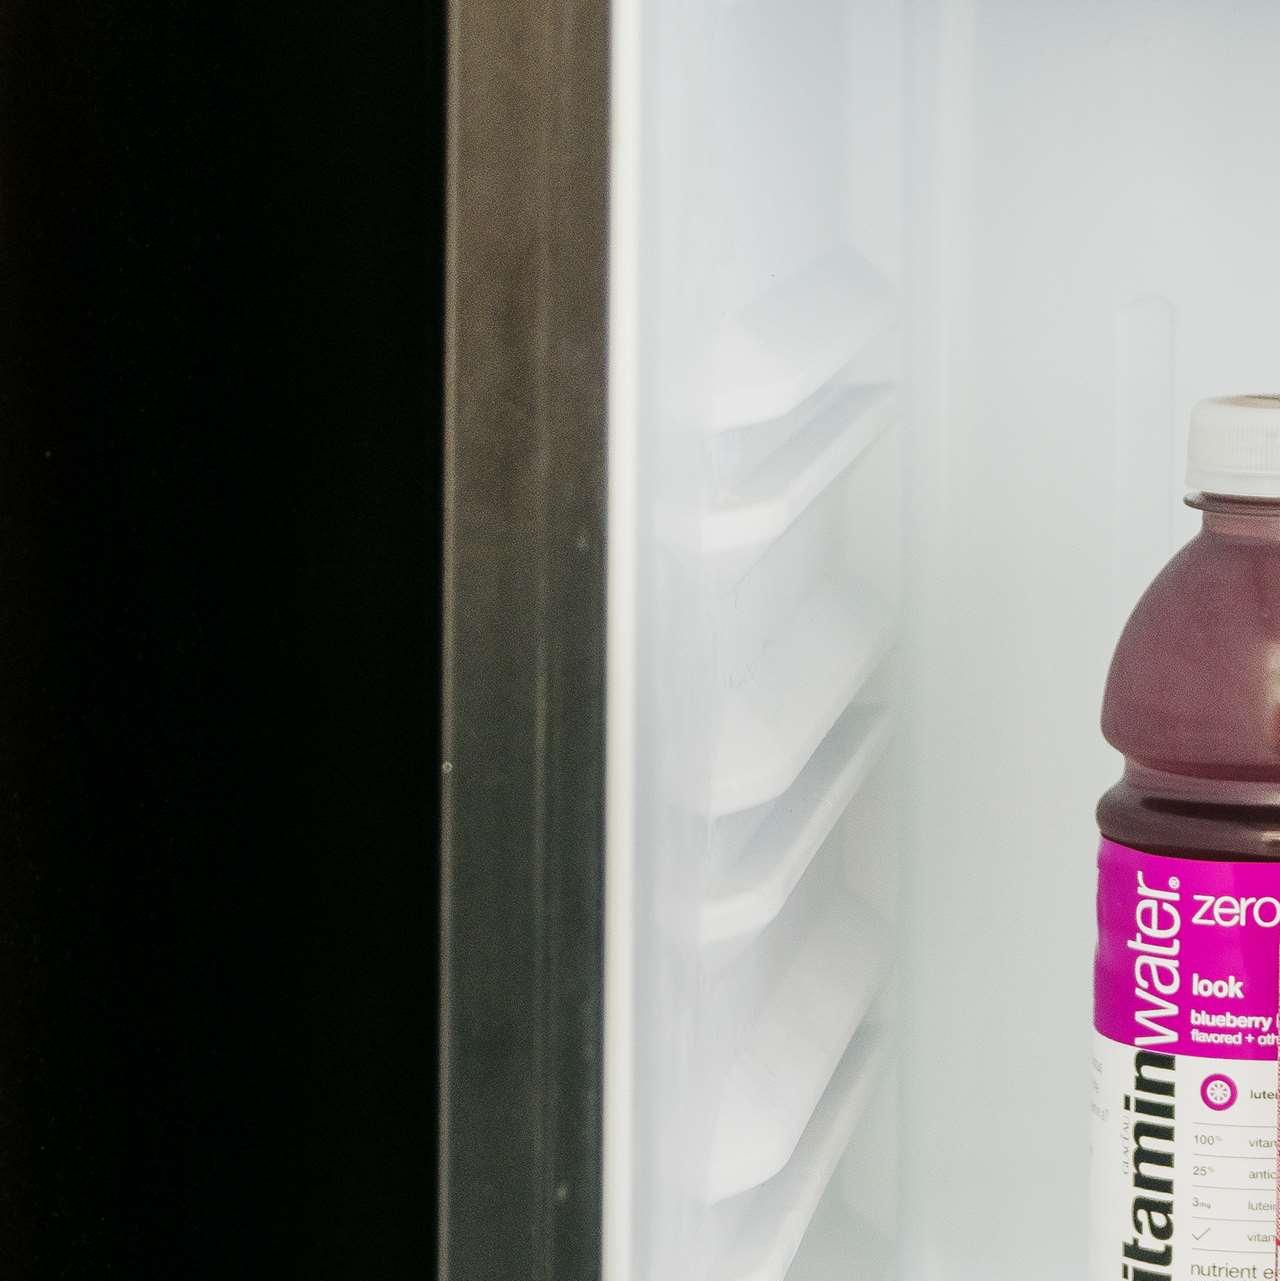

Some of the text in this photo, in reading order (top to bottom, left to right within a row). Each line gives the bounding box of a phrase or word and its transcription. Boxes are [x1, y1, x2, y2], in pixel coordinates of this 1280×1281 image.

[1192, 973, 1244, 999] look
[1190, 1008, 1273, 1032] blueberry
[1190, 1028, 1255, 1045] flavored +
[1190, 1263, 1256, 1280] nutrient
